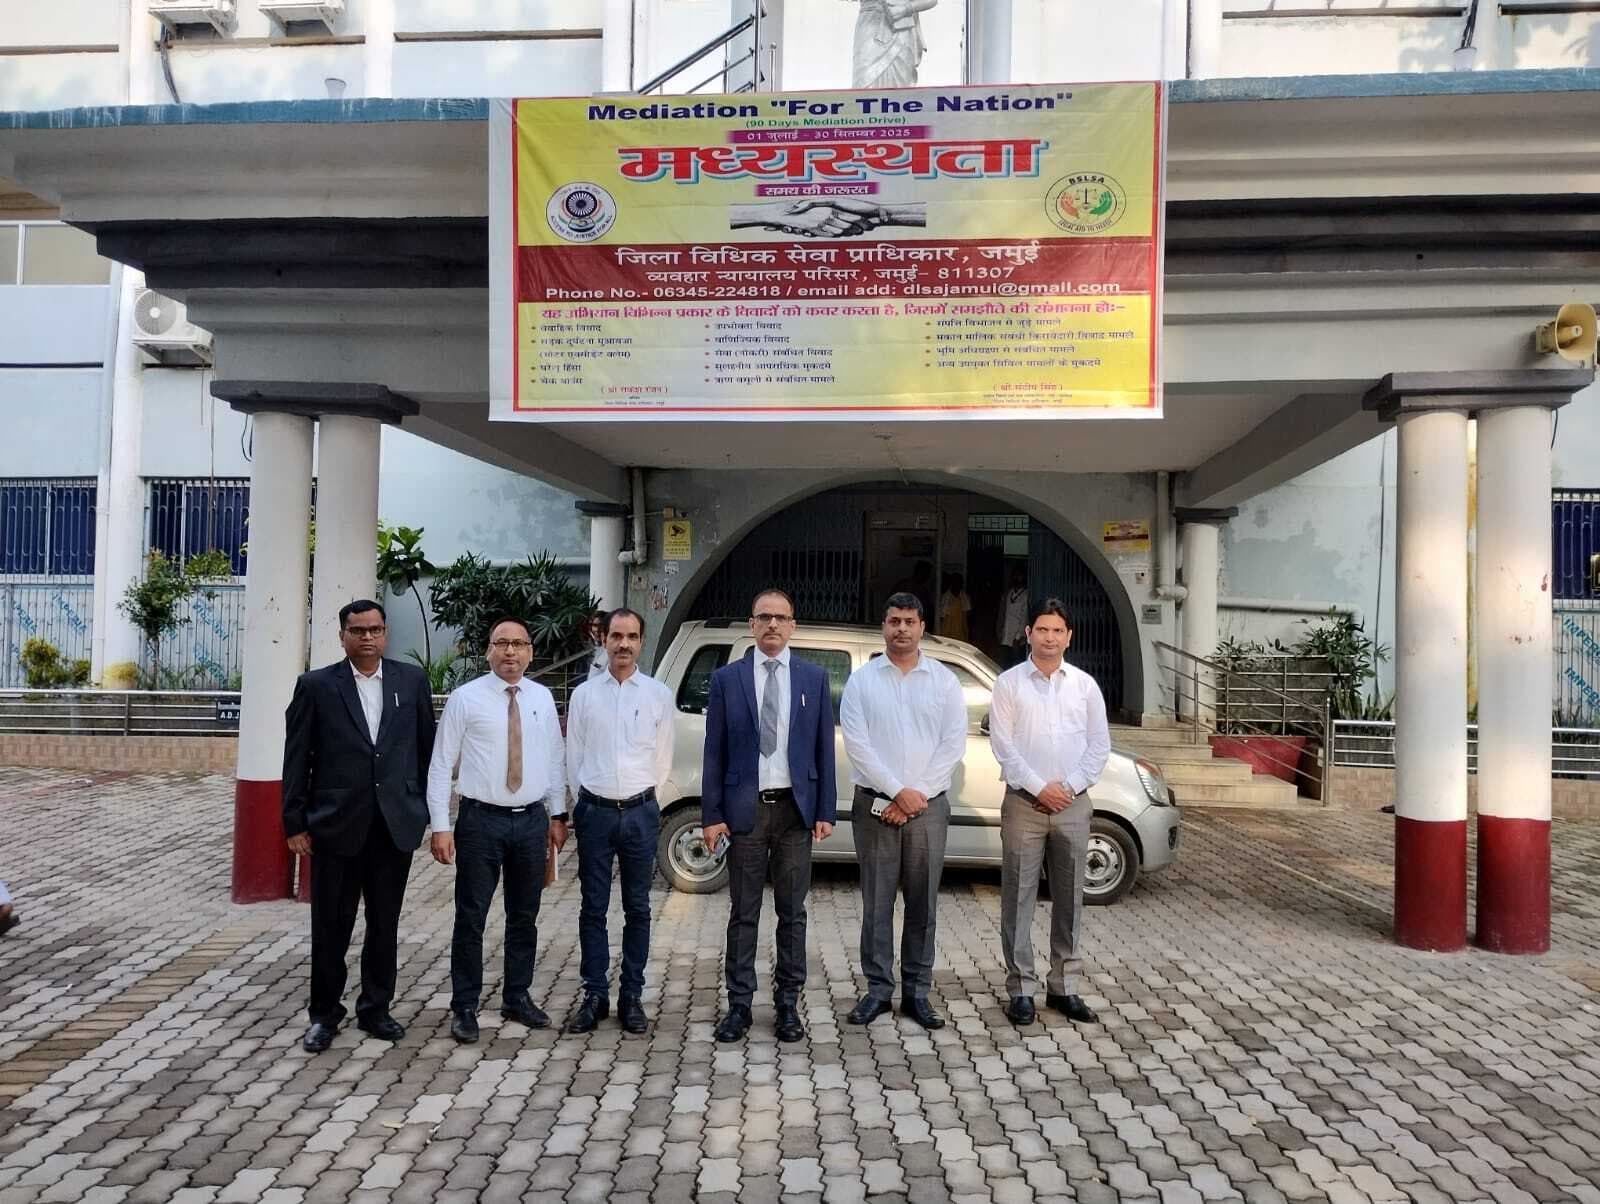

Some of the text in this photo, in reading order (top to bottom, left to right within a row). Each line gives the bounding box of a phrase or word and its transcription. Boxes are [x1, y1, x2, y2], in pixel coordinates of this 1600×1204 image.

[588, 92, 1072, 121] Mediation "For The Nation"
[746, 116, 906, 128] (90 Days Mediation Drive)
[747, 133, 761, 141] 01
[766, 129, 798, 141] जुलाई
[814, 131, 828, 139] 30
[880, 129, 911, 137] 2025
[618, 139, 1048, 184] मध्यस्थता
[1069, 175, 1104, 184] BSLSA
[765, 187, 799, 196] समय
[802, 184, 821, 195] की
[615, 248, 682, 265] जिला
[689, 246, 777, 264] विधिक
[784, 244, 838, 264] सेवा
[977, 240, 1041, 265] जमुई
[646, 271, 711, 284] व्यवहार
[717, 269, 797, 282] न्यायालय
[938, 267, 1015, 279] 811307
[546, 281, 1121, 299] Phone No.- 06345-224818 / email add: dlsajamui@gmail.com
[542, 309, 561, 319] यह
[676, 306, 713, 318] प्रकार
[716, 304, 729, 318] के
[735, 303, 779, 318] विवादों
[783, 304, 801, 317] को
[805, 306, 838, 317] कवर
[842, 305, 880, 316] करता
[1010, 301, 1030, 314] की
